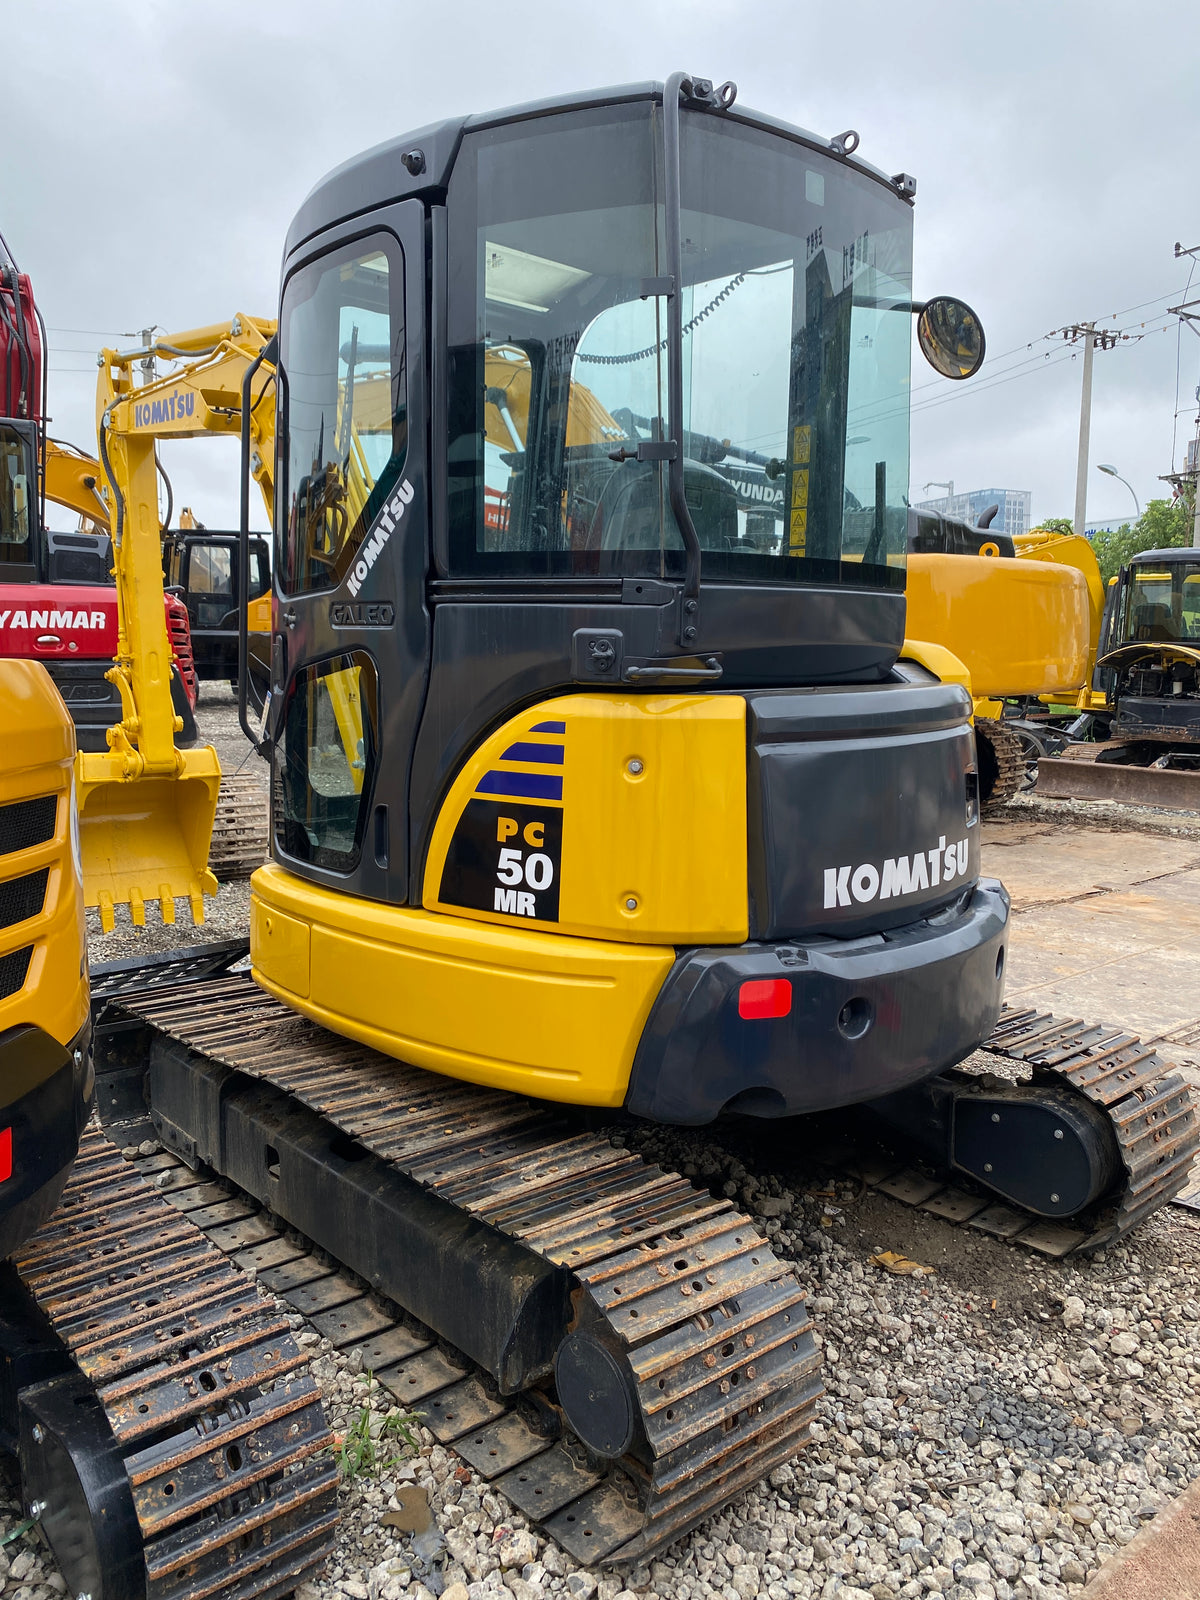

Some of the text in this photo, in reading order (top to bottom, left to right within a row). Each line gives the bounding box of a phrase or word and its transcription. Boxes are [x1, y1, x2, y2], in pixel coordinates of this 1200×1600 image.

[135, 389, 195, 428] KOMATSU
[727, 479, 785, 505] YUNDA
[346, 478, 415, 598] KOMATSU
[0, 610, 106, 630] YANMAR
[331, 605, 395, 625] GALEO
[496, 816, 545, 848] PC
[496, 847, 554, 891] 50
[823, 835, 969, 910] KOMATSU
[493, 887, 536, 917] MR
